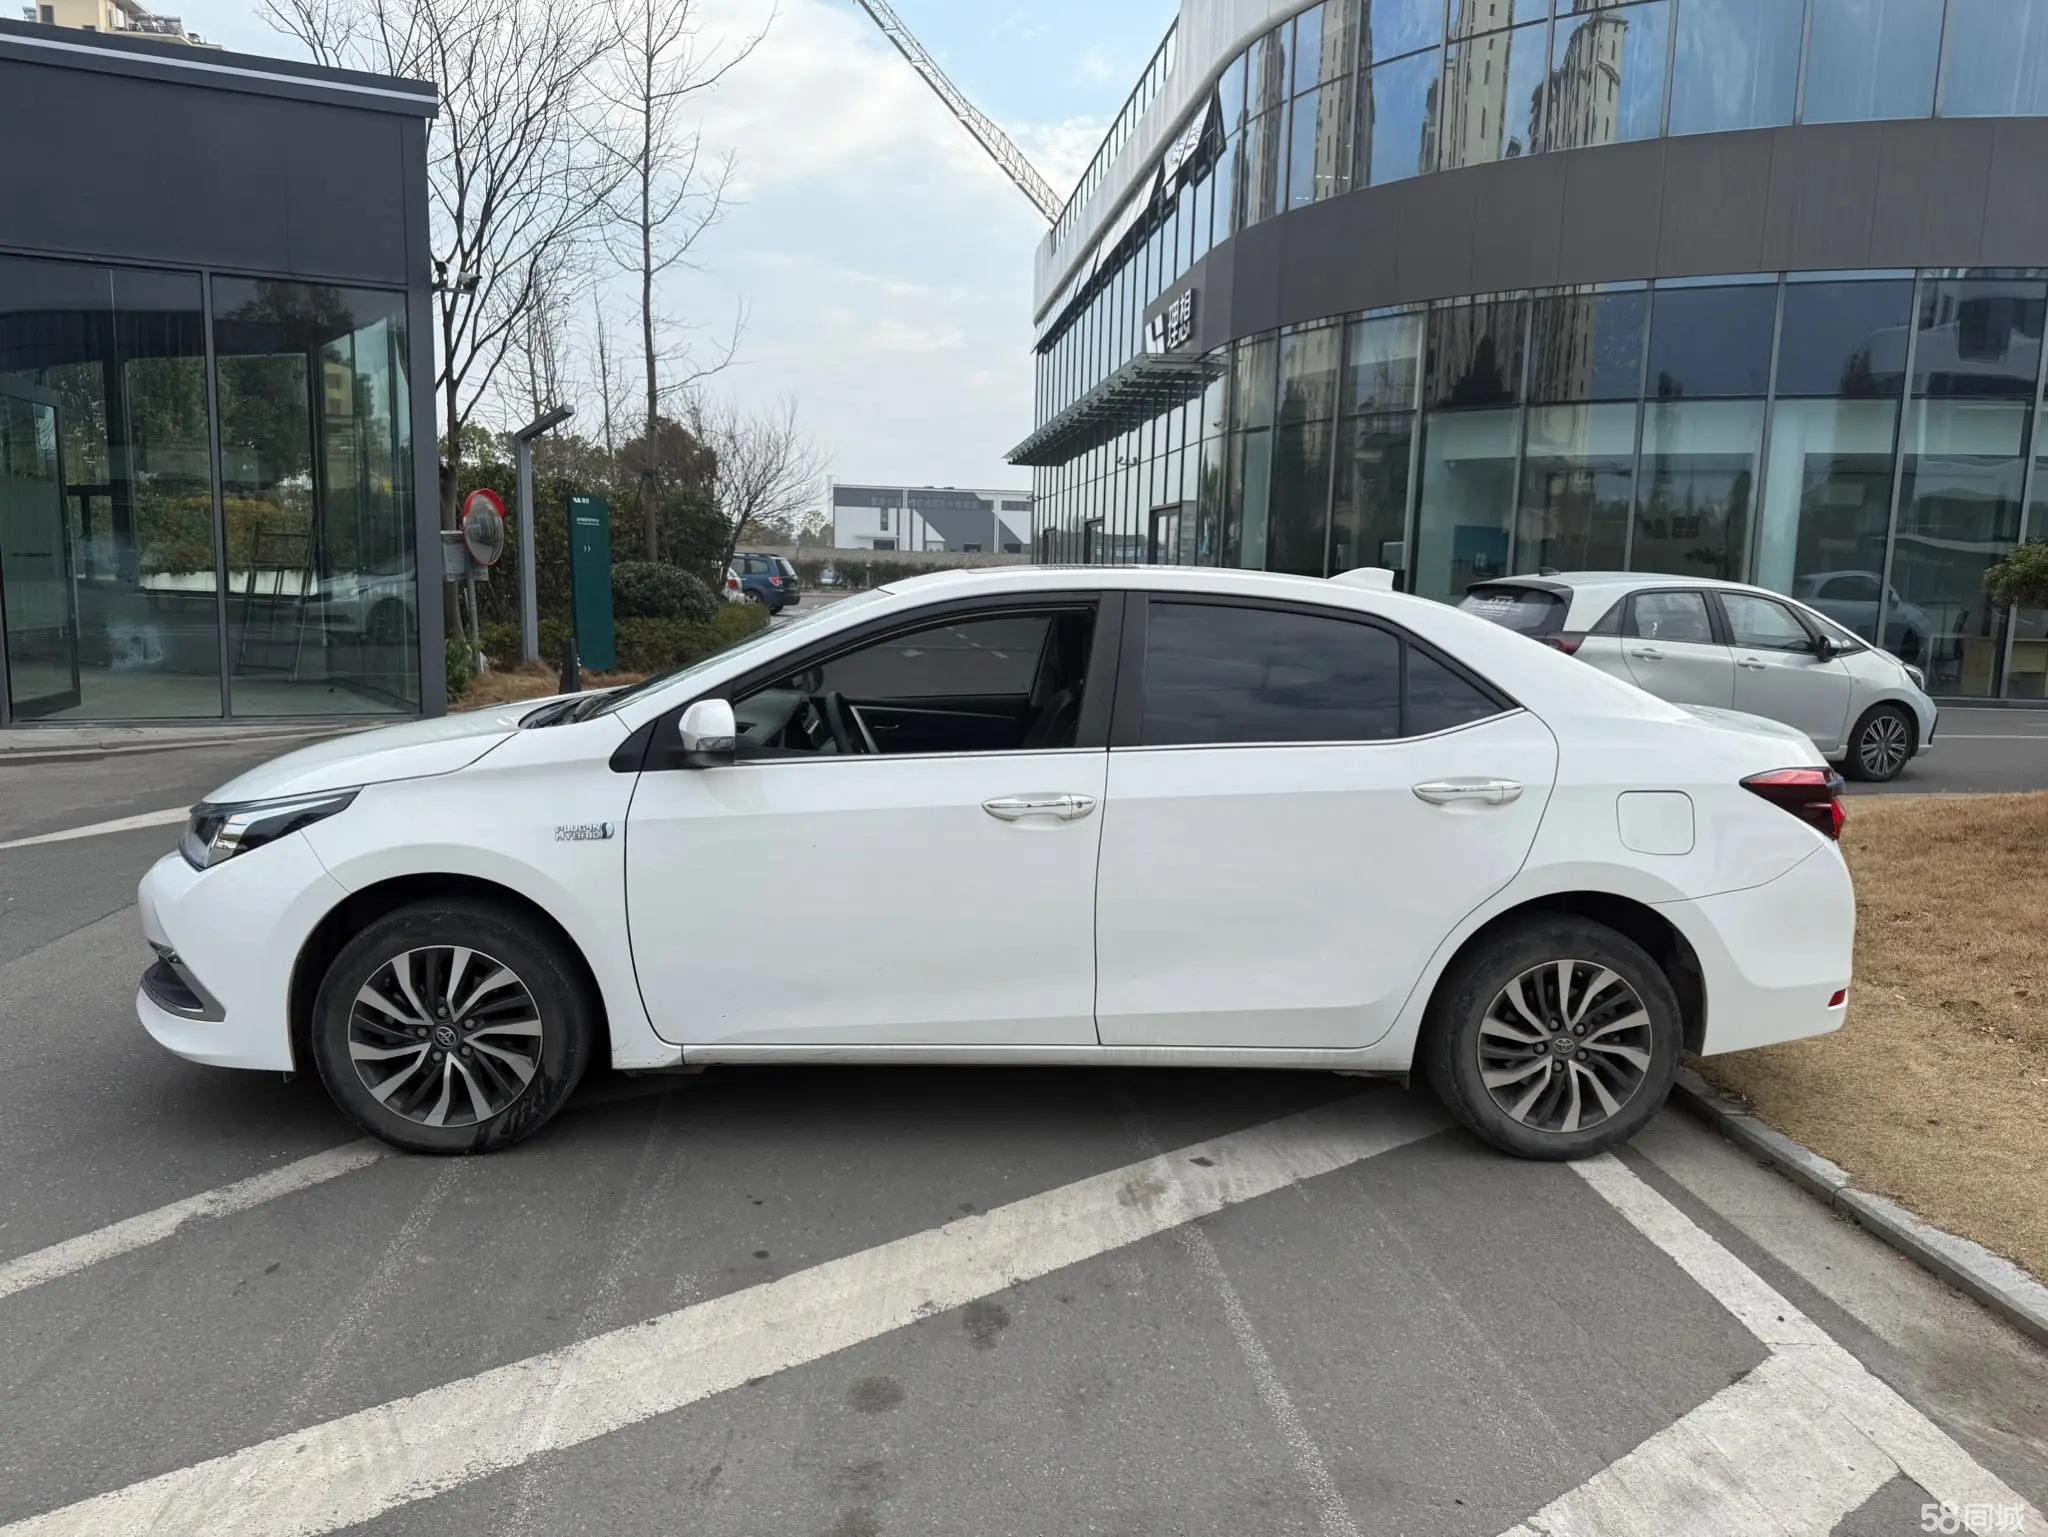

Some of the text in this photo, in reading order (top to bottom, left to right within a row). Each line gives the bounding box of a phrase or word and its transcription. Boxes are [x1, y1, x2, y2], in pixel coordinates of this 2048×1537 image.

[1167, 288, 1192, 349] 理想
[555, 824, 601, 832] PLUG-IN
[555, 831, 602, 841] HYBRID
